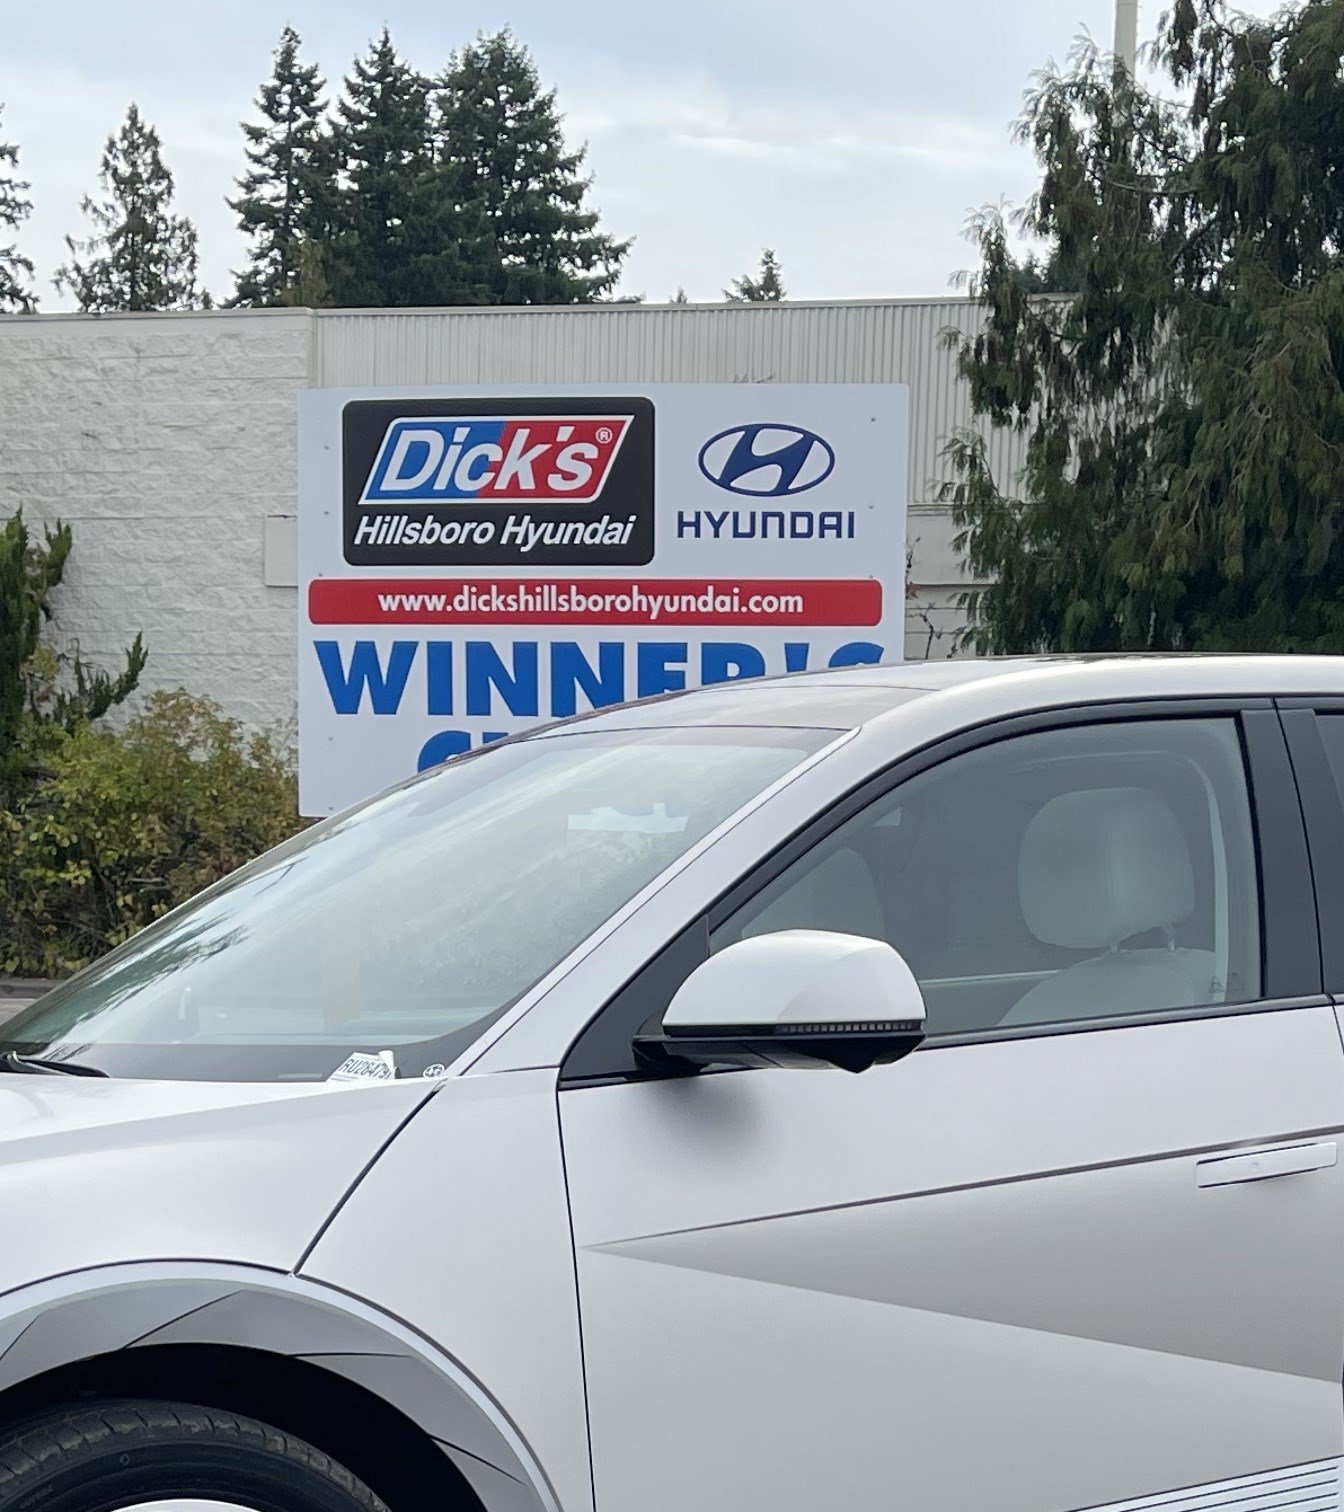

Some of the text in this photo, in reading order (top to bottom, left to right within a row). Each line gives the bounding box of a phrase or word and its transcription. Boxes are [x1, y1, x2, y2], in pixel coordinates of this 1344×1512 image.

[379, 426, 600, 493] Dick's
[354, 514, 637, 553] Hillsboro Hyundai
[677, 510, 855, 539] HYUNDAI
[378, 585, 804, 620] www.dickshillsborohyundai.com
